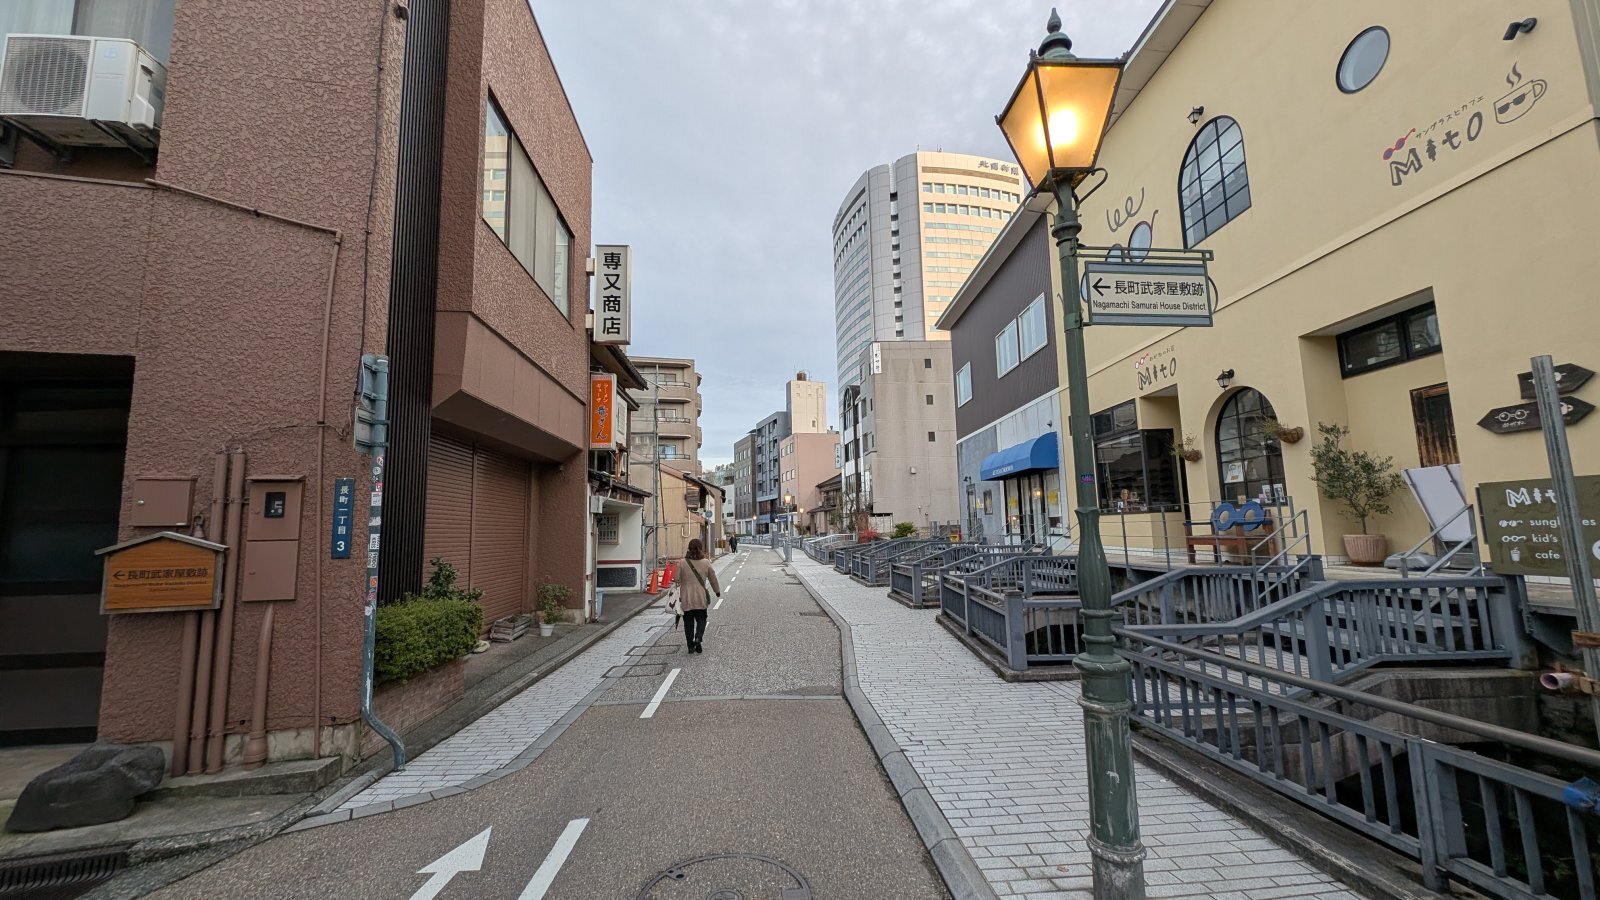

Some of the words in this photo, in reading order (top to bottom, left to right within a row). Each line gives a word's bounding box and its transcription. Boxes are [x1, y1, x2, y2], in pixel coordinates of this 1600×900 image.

[602, 252, 622, 335] 専又商店
[1114, 280, 1205, 296] 長町武家屋敷跡
[1092, 300, 1130, 310] Nagamachi
[1131, 301, 1159, 310] Samurai
[1159, 302, 1181, 310] House
[1182, 302, 1206, 311] District
[1531, 533, 1559, 543] kid's
[336, 540, 345, 552] 3
[1535, 549, 1561, 560] cafe
[127, 567, 209, 580] 長町武家屋敷跡
